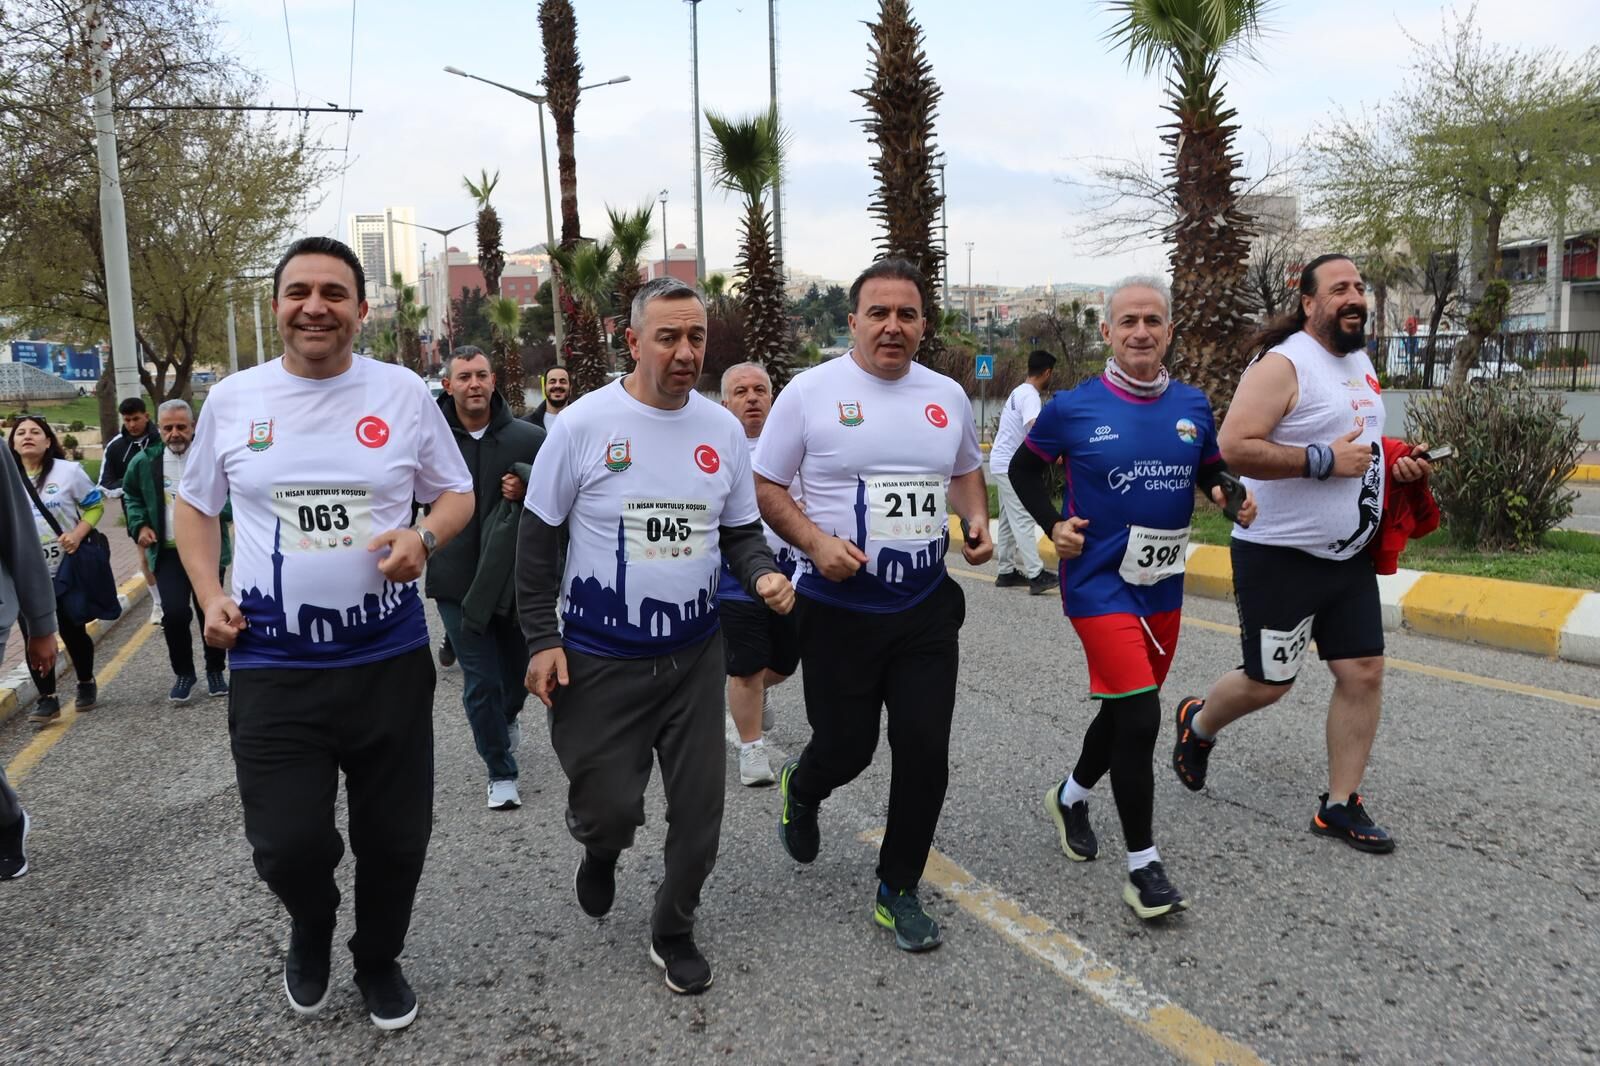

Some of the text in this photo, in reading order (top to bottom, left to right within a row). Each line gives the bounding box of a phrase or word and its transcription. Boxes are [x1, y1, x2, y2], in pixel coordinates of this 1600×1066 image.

[1134, 465, 1193, 479] KASAPTAŞI
[275, 491, 283, 499] 11
[285, 489, 305, 498] NİSAN
[341, 489, 367, 498] KOŞUSU
[636, 501, 654, 509] NİSAN
[655, 502, 685, 511] KURTULUŞ
[685, 503, 707, 511] KOŞUSU
[884, 492, 937, 518] 214
[298, 504, 350, 532] 063
[646, 517, 692, 542] 045
[1137, 544, 1180, 568] 398
